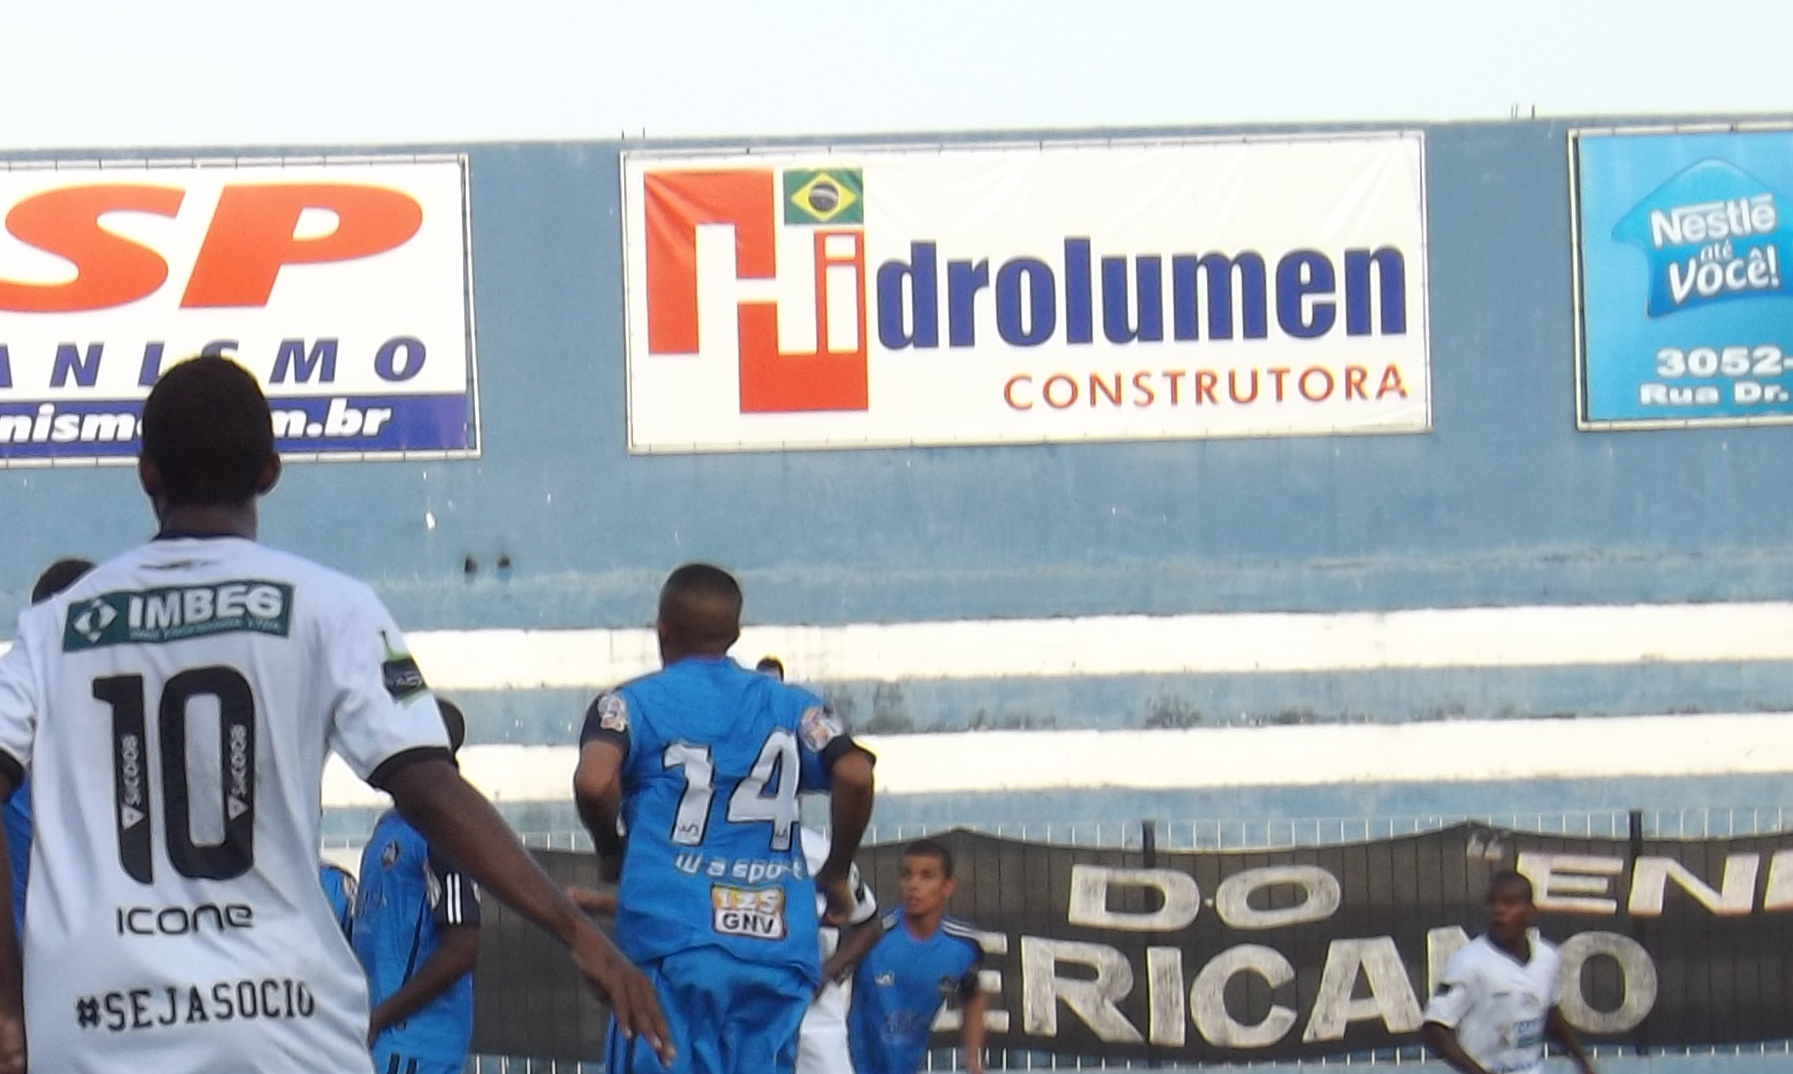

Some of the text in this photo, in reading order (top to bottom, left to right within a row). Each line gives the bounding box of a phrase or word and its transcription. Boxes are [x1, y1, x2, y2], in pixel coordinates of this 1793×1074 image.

[1649, 193, 1777, 249] Nestlé
[1668, 245, 1782, 305] Você!
[1004, 364, 1410, 411] CONSTRUTORA
[1639, 382, 1790, 407] Rua Dr.
[92, 665, 256, 884] 10
[663, 727, 801, 853] 14
[722, 912, 775, 934] GNV
[75, 977, 316, 1033] #SEJASOCIO
